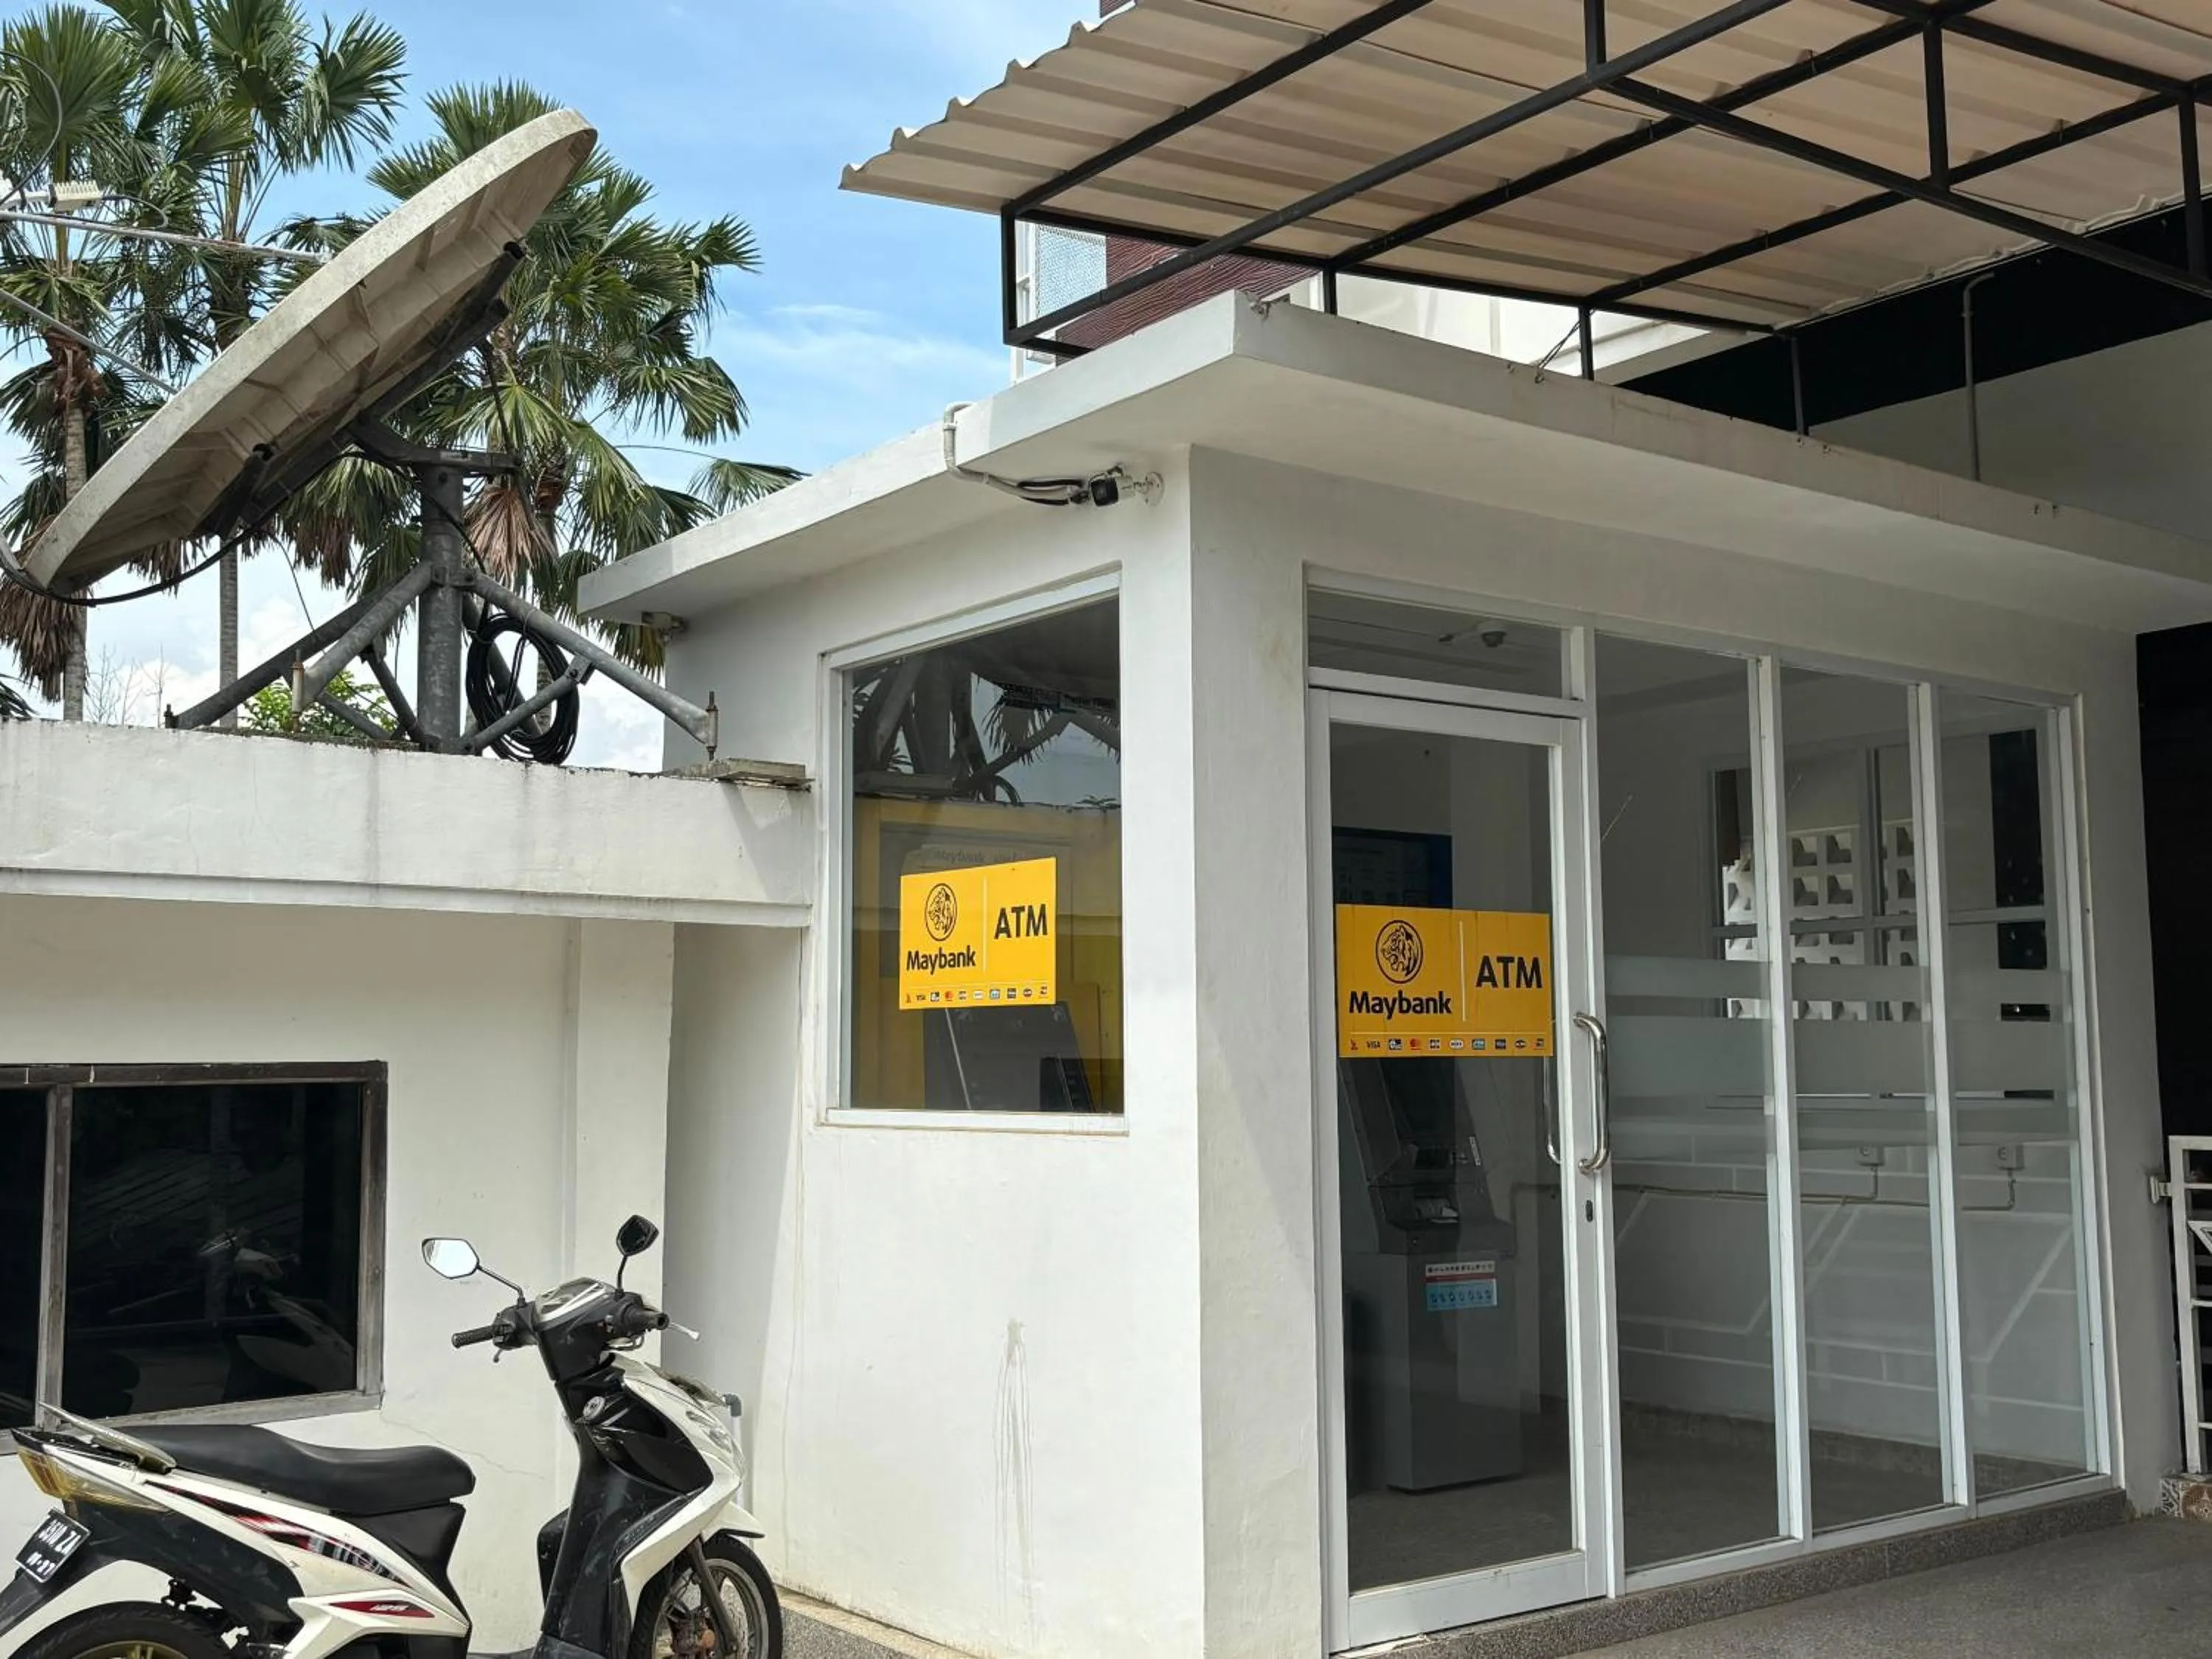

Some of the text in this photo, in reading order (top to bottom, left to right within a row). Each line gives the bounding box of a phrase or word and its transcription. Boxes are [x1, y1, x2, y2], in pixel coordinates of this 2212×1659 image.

[994, 903, 1048, 939] ATM
[906, 945, 976, 975] Maybank
[1475, 956, 1543, 989] ATM
[1349, 990, 1452, 1020] Maybank
